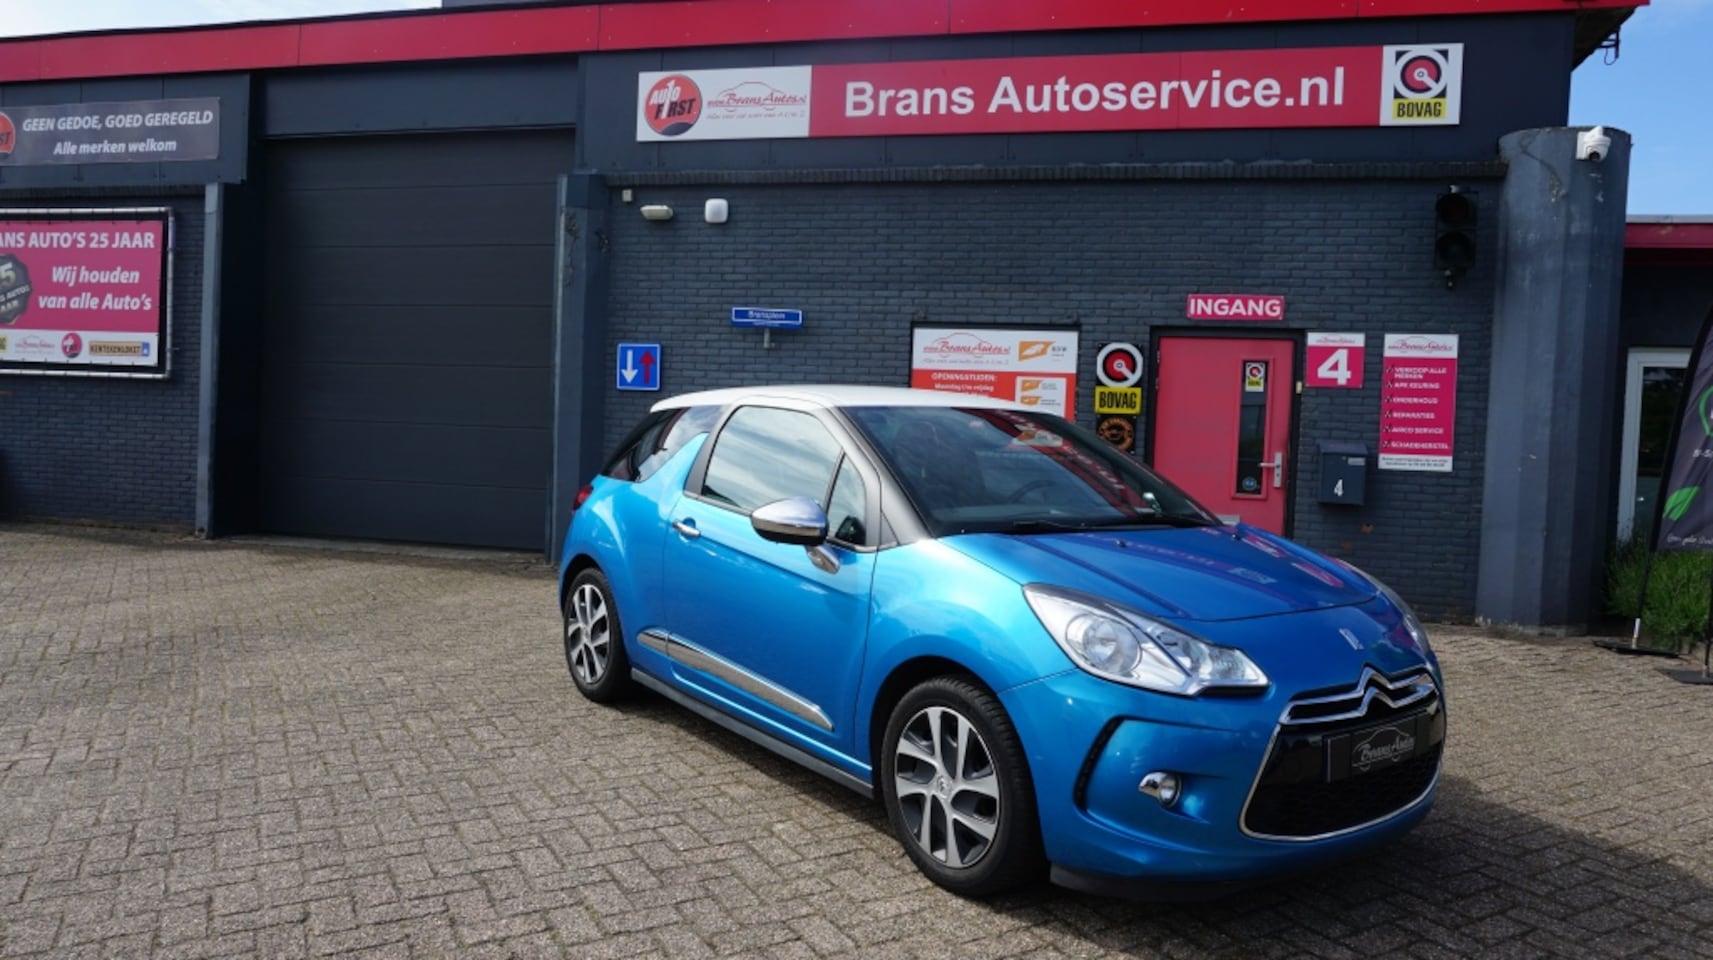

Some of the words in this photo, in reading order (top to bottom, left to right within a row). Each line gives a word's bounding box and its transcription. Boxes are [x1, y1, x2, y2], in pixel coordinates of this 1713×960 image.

[845, 81, 976, 117] Brans
[987, 66, 1345, 113] Autoservice.nl
[1397, 101, 1442, 118] BOVAG
[22, 118, 55, 132] GEEN
[57, 115, 102, 131] GEDOE,
[105, 113, 143, 129] GOED
[144, 110, 213, 127] GEREGELD
[53, 141, 77, 155] Alle
[79, 140, 127, 154] merken
[128, 138, 177, 152] welkom
[28, 231, 86, 248] AUTO'S
[89, 231, 110, 248] 25
[111, 231, 155, 248] JAAR
[52, 265, 78, 288] Wij
[79, 265, 140, 284] houden
[38, 295, 67, 309] van
[70, 292, 99, 309] alle
[101, 293, 152, 311] Auto's
[1189, 298, 1281, 317] INGANG
[1317, 348, 1352, 386] 4
[1099, 391, 1137, 409] BOVAG
[1333, 479, 1345, 496] 4
